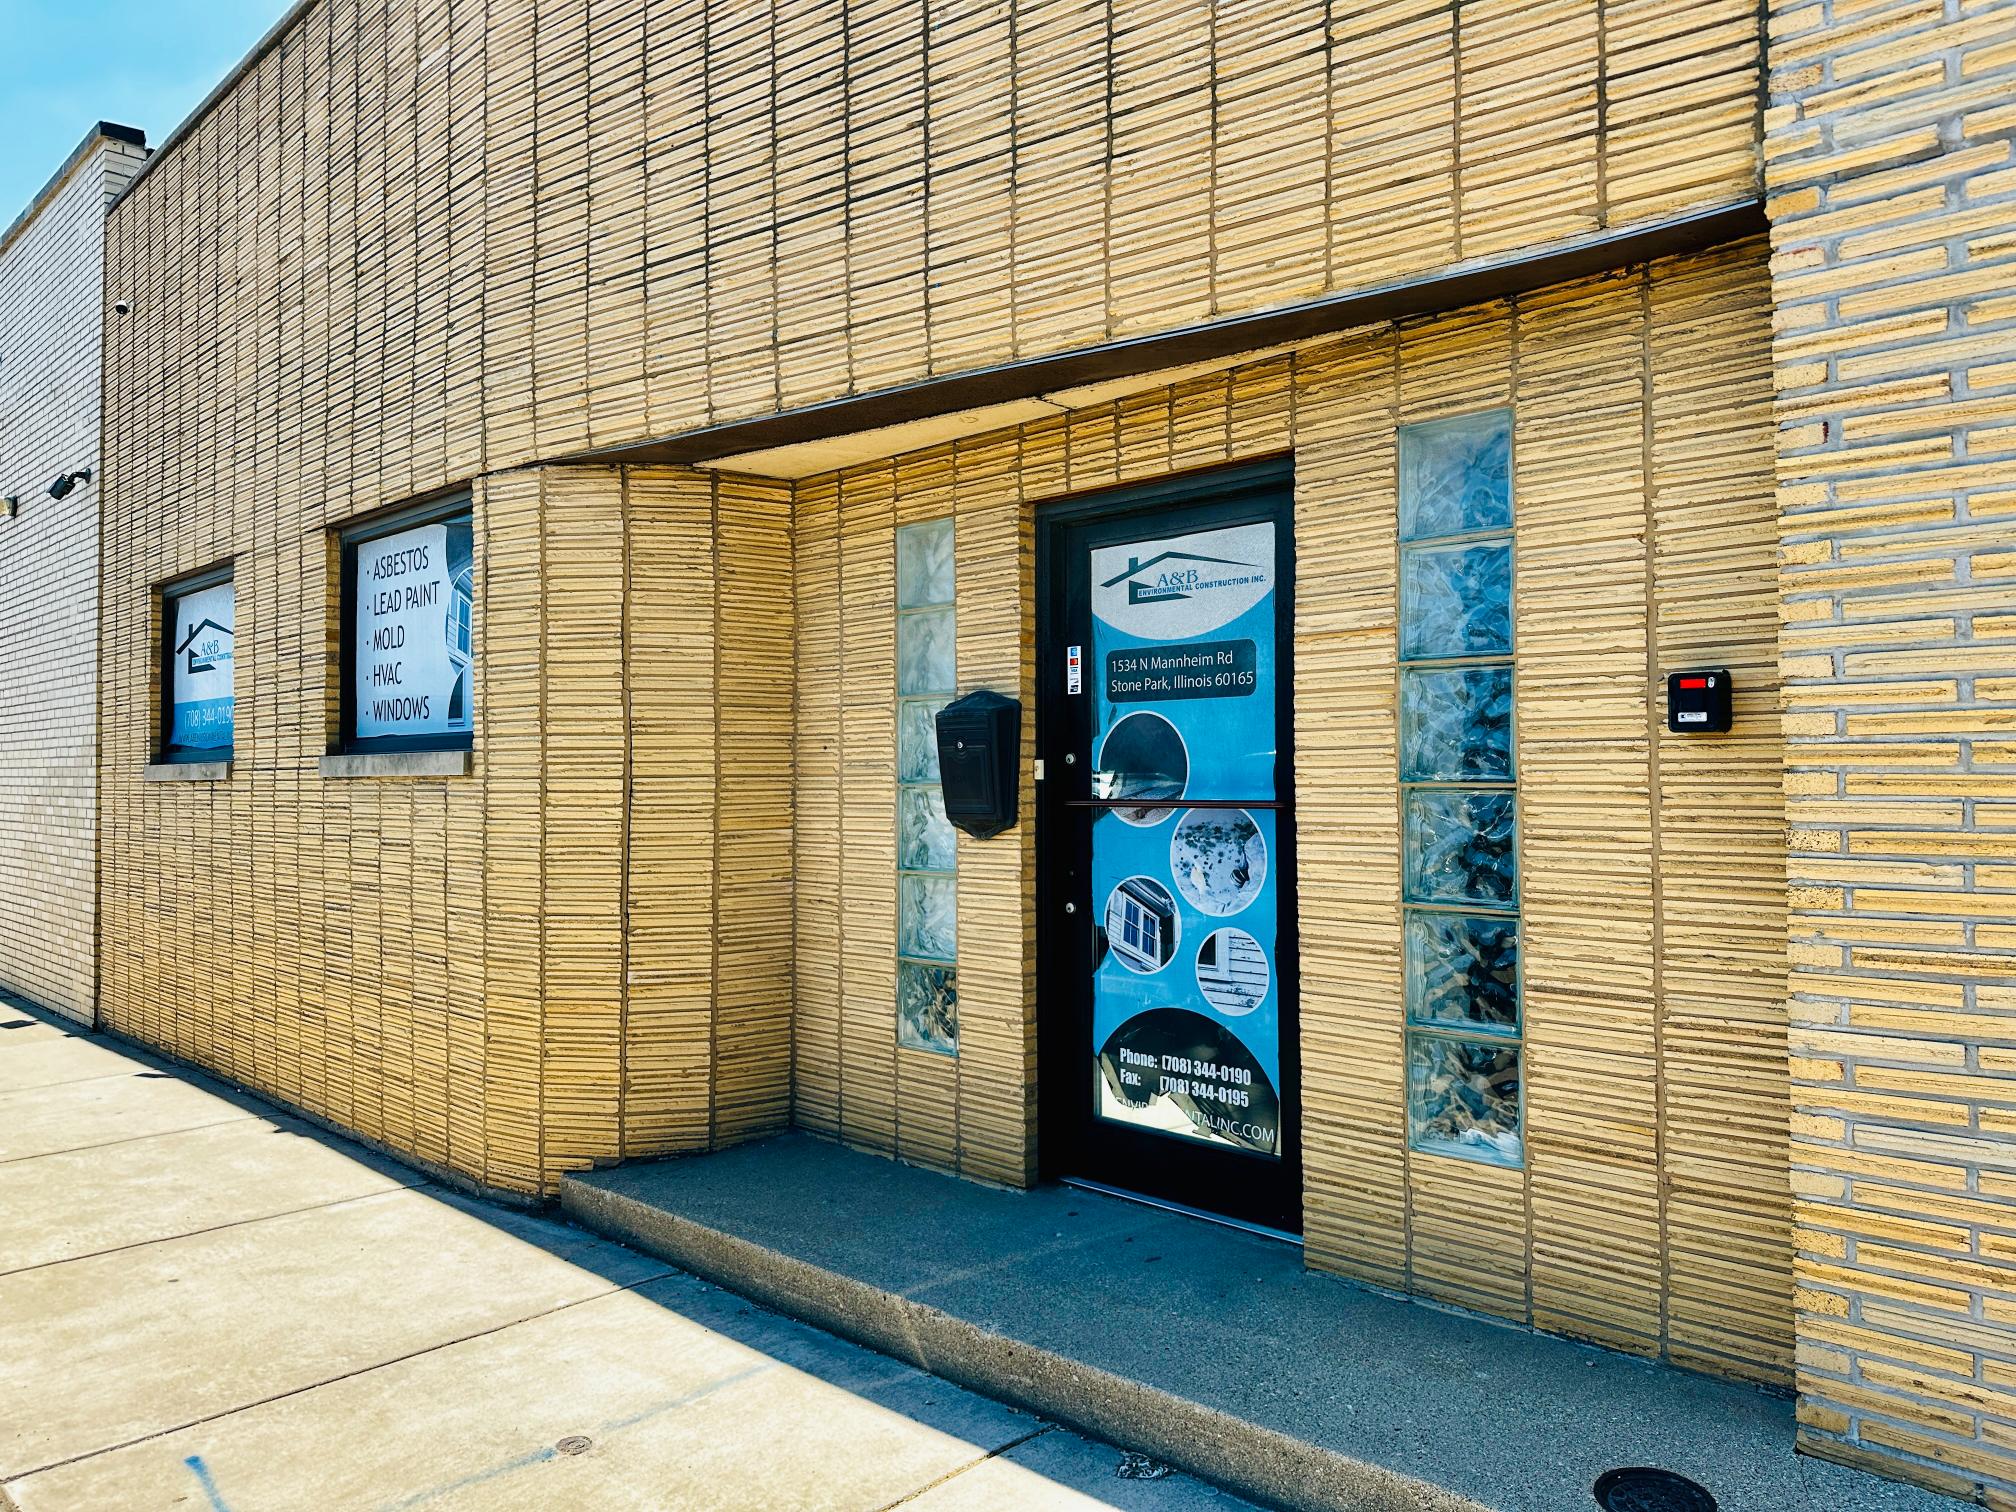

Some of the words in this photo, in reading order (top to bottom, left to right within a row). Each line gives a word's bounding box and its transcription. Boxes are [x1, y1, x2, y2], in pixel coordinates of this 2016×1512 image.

[373, 545, 429, 581] ASBESTOS
[1138, 583, 1193, 596] ENVIRONMENTAL
[1195, 577, 1249, 590] CONSTRUCTION
[1251, 574, 1266, 583] INC.
[1157, 569, 1198, 587] A&B
[374, 589, 402, 616] LEAD
[406, 580, 440, 611] PAINT
[200, 639, 219, 656] A&B
[373, 625, 405, 652] MOLD
[373, 661, 402, 687] HVAC
[1112, 658, 1137, 673] 1534
[1139, 658, 1148, 670] N
[1151, 652, 1213, 670] Mannheim
[1217, 650, 1233, 665] Rd
[1112, 679, 1141, 693] Stone
[1144, 676, 1170, 692] Park,
[1174, 672, 1212, 689] Illinois
[1215, 671, 1254, 687] 60165
[184, 709, 201, 729] (708)
[373, 695, 430, 723] WINDOWS
[1119, 1047, 1158, 1069] Phone:
[1161, 1055, 1192, 1075] (708)
[1193, 1060, 1252, 1086] 344-0190
[1120, 1068, 1141, 1087] Fax:
[1159, 1076, 1190, 1095] (708)
[1191, 1081, 1249, 1108] 344-0195
